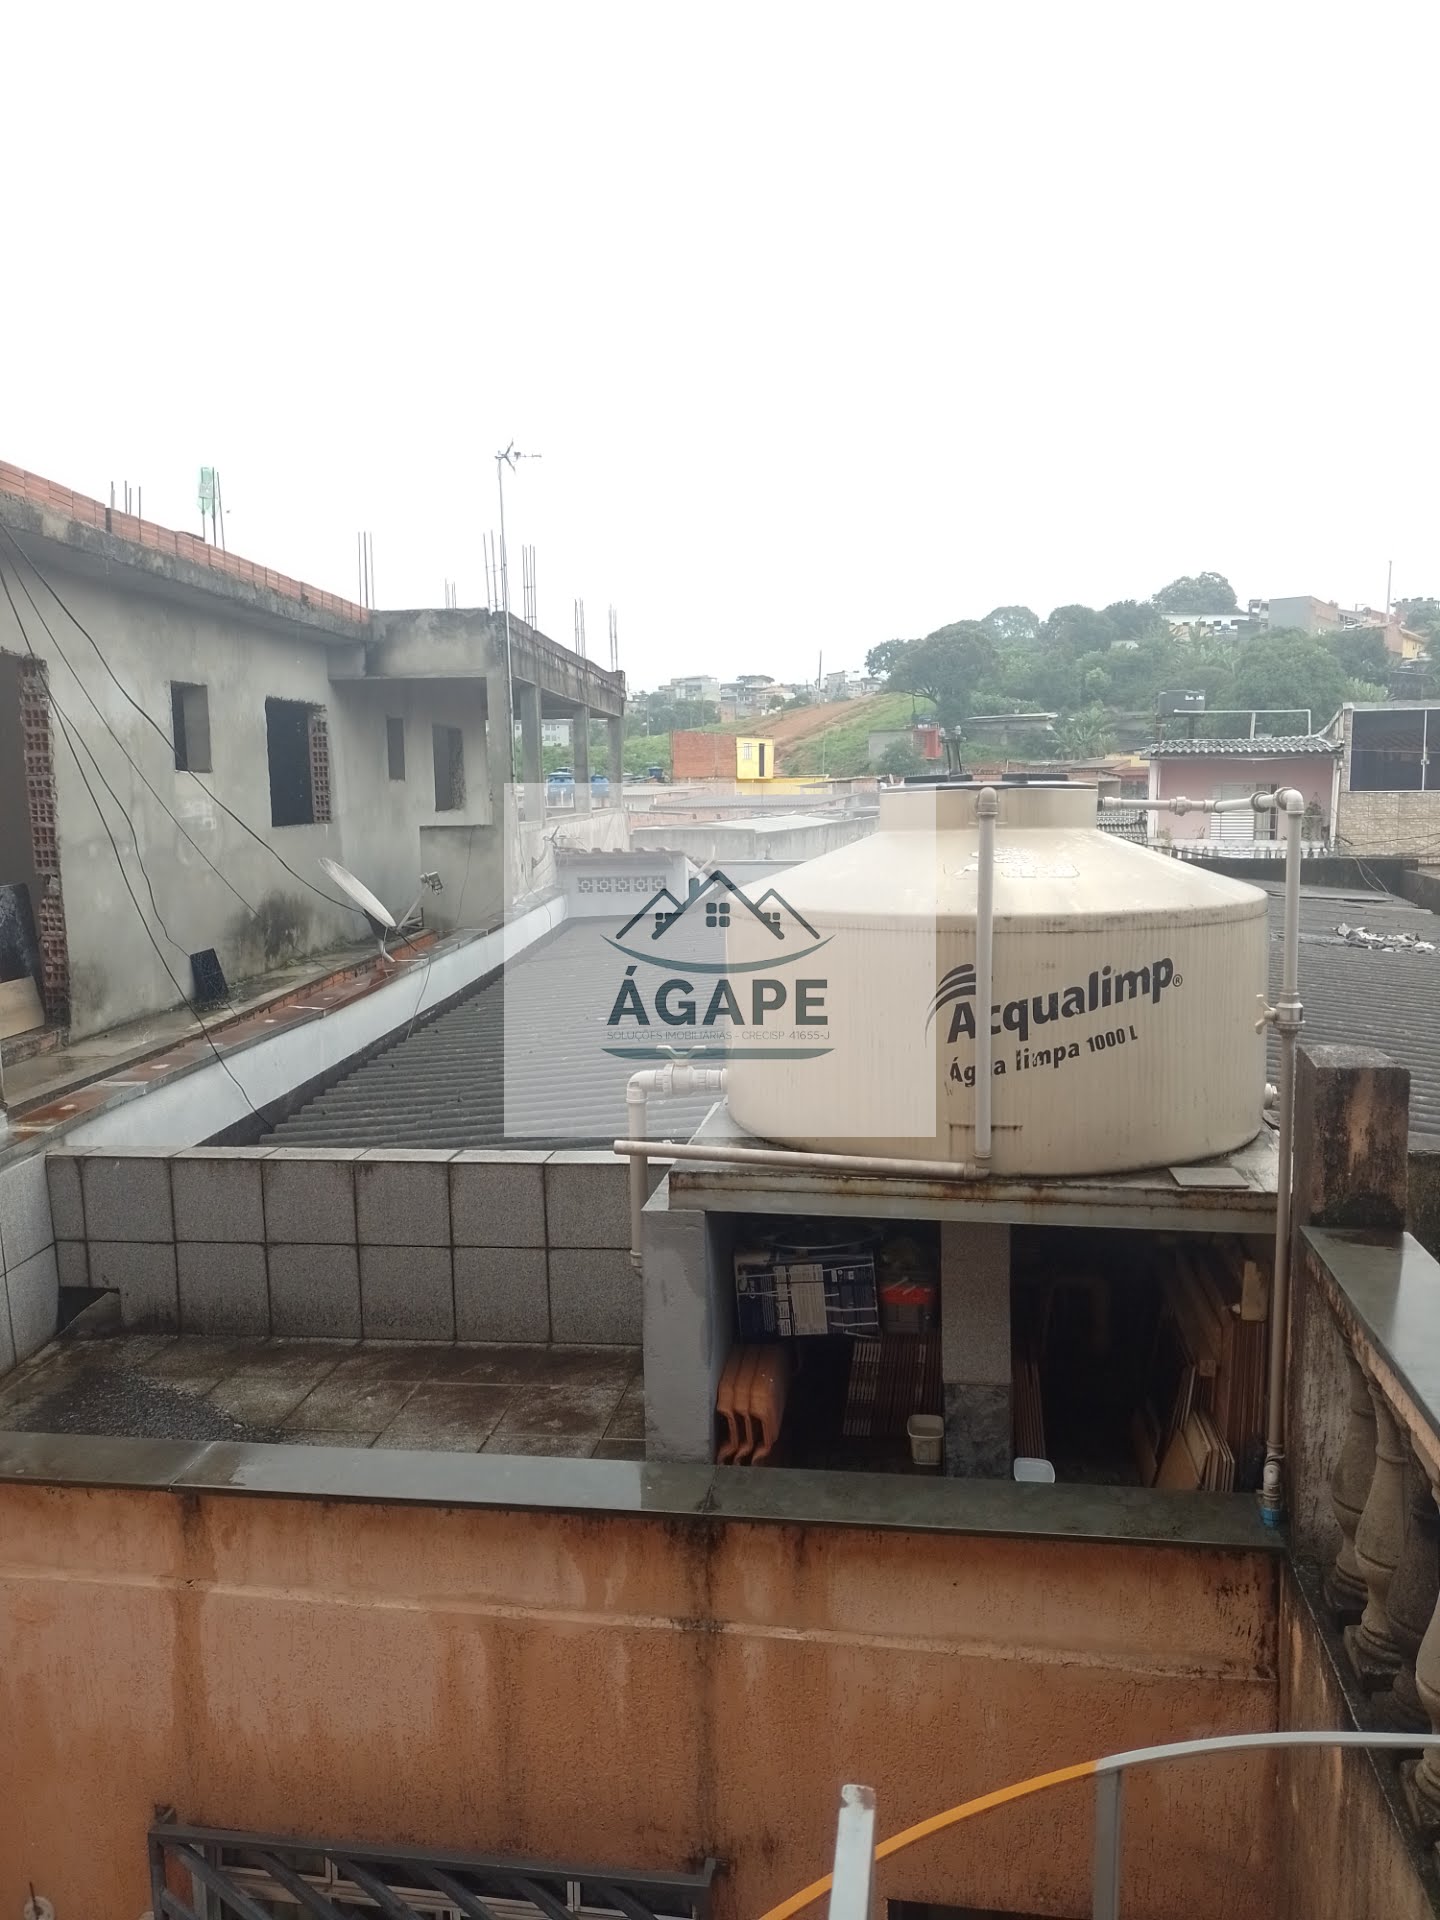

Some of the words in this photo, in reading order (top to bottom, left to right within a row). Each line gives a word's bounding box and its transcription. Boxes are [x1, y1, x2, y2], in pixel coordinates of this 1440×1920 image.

[950, 1056, 1006, 1088] Ága
[1015, 1042, 1080, 1071] limpa
[1086, 1028, 1126, 1052] 1000
[1124, 1025, 1138, 1041] L
